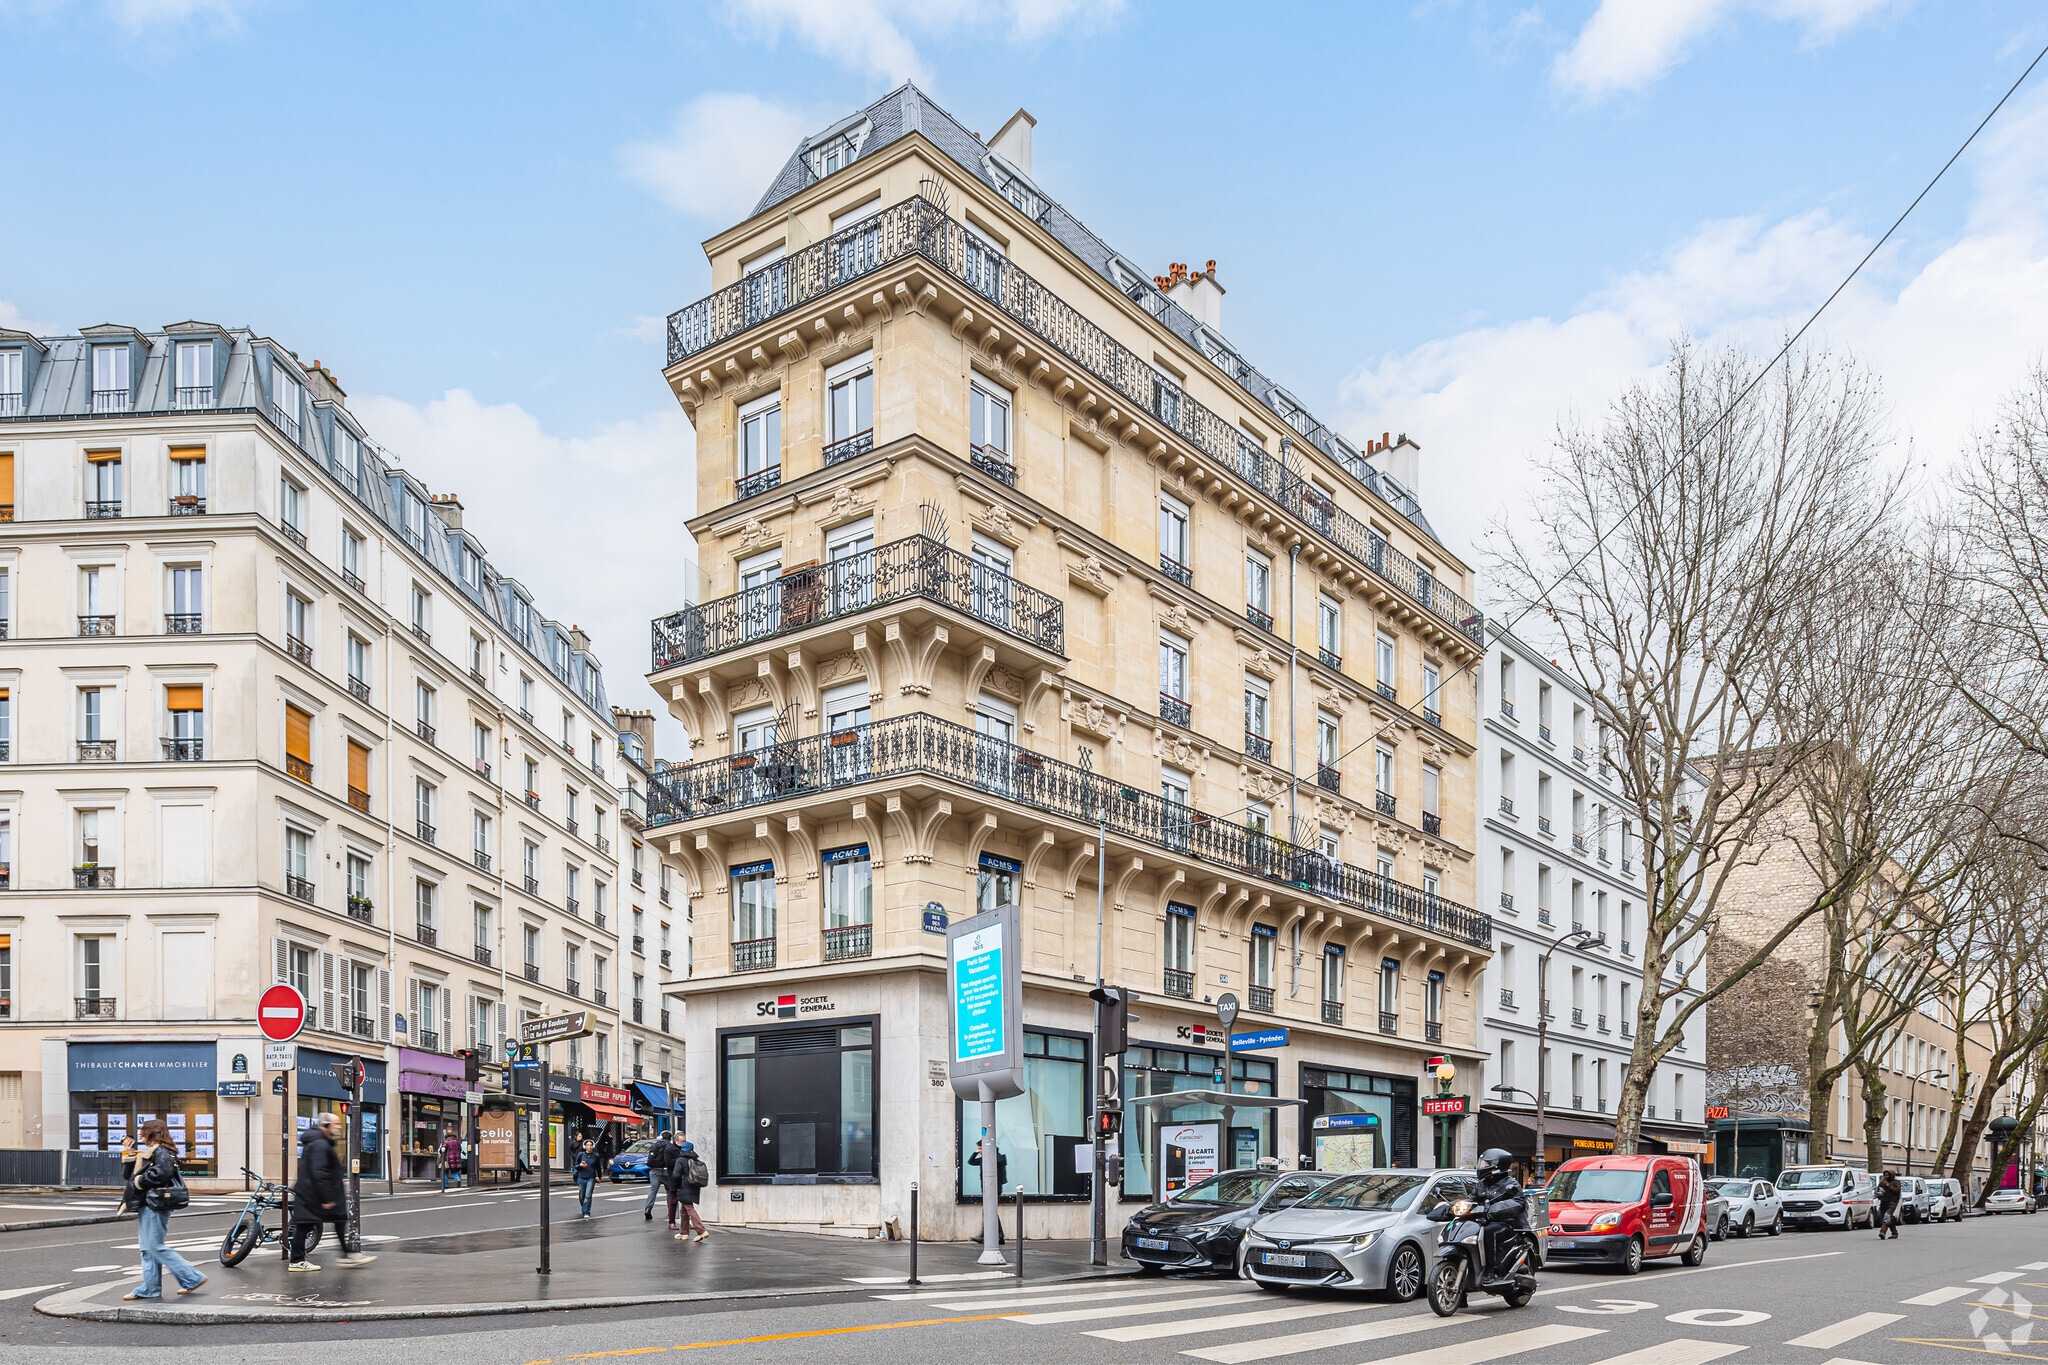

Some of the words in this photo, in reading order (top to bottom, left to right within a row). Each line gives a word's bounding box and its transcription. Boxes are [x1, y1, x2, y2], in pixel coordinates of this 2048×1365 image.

[832, 848, 860, 859] ACMS
[739, 864, 764, 874] ACMS
[988, 858, 1012, 870] ACMS
[1169, 904, 1188, 915] ACMS
[1254, 926, 1272, 936] ACMS
[967, 958, 978, 967] Paris
[978, 955, 990, 965] Sport
[968, 964, 989, 975] Vacances
[969, 980, 981, 988] stages
[982, 989, 999, 999] pendant
[800, 996, 828, 1004] SOCIETE
[973, 1000, 991, 1008] vacances
[756, 1002, 775, 1016] SG
[800, 1004, 835, 1012] GENERALE
[1218, 1002, 1236, 1012] TAXI
[1177, 1026, 1190, 1039] SG
[298, 1066, 328, 1076] THIBAULT
[365, 1076, 385, 1084] OBILIER
[592, 1090, 610, 1099] L'ATELIER
[612, 1093, 626, 1102] PAPIER
[1427, 1101, 1462, 1112] METRO
[1707, 1107, 1729, 1118] PIZZA
[481, 1128, 512, 1137] celio
[1573, 1139, 1595, 1148] PRIMEURS
[1596, 1140, 1604, 1149] DES
